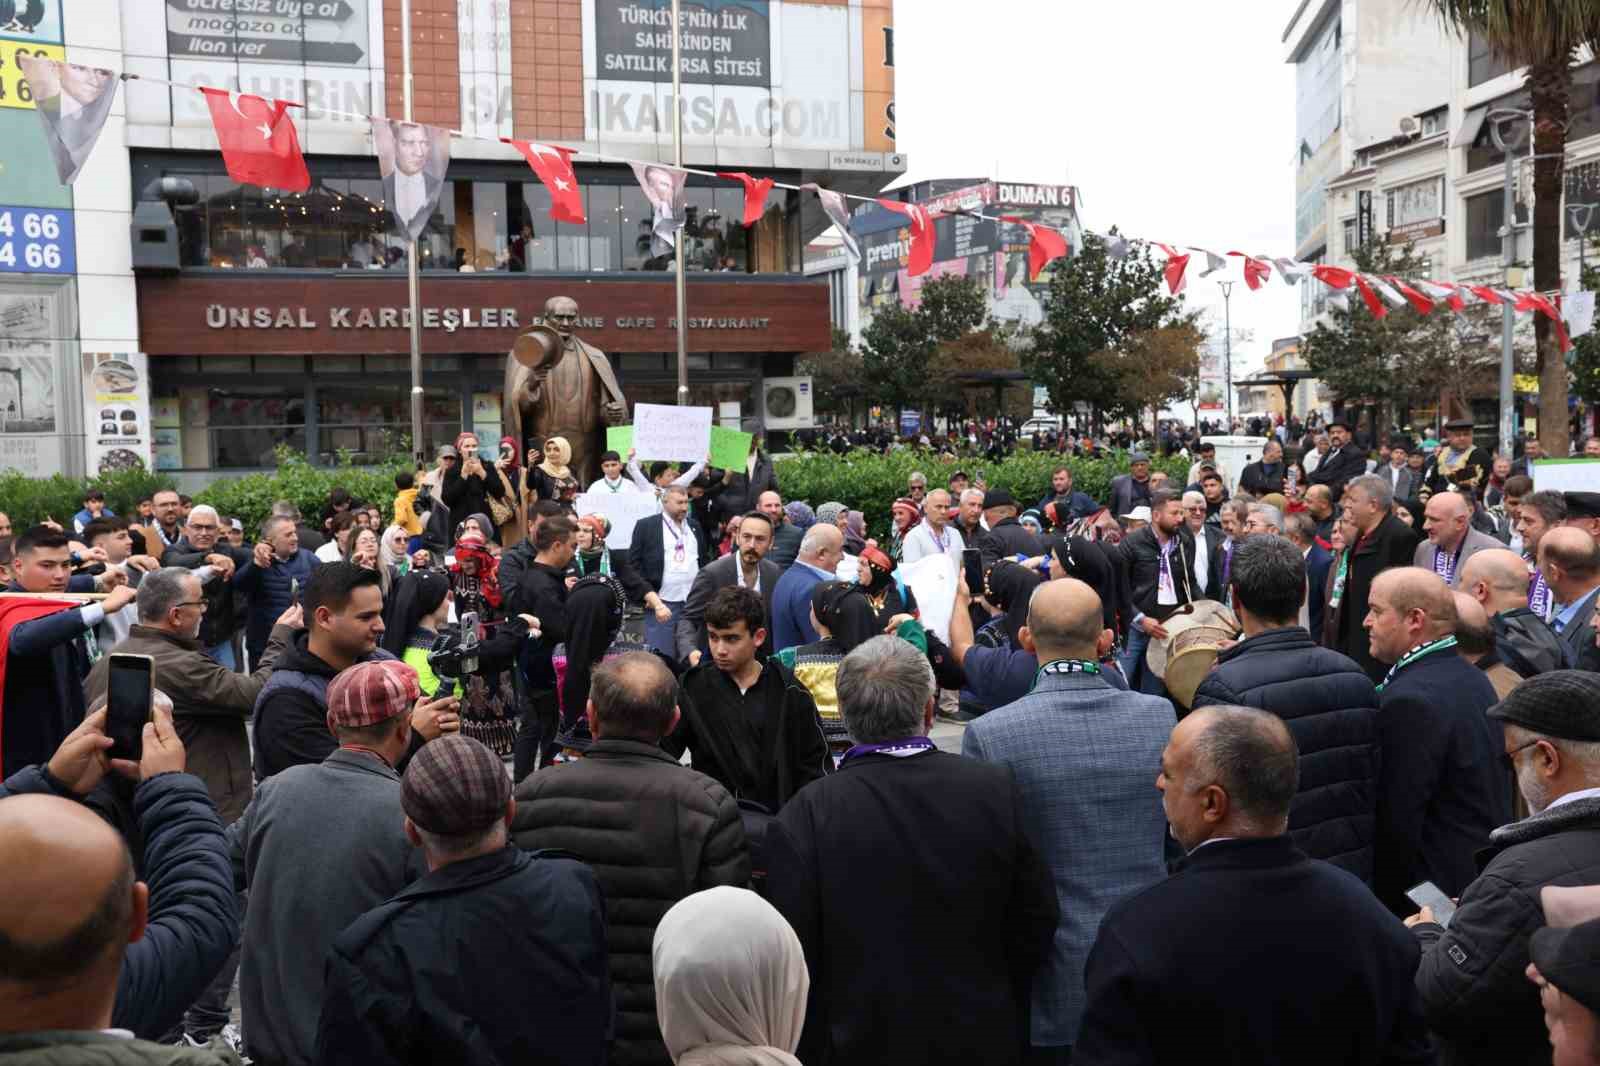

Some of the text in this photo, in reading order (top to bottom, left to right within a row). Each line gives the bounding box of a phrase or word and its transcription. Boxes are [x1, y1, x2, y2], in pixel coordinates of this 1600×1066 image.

[319, 1, 338, 17] ol
[721, 10, 748, 31] İLK
[635, 30, 732, 52] SAHİİNDEN
[604, 54, 763, 77] SATILIK RSA SİTESİ
[999, 184, 1058, 204] DUMAN
[1061, 187, 1071, 206] 6
[23, 212, 60, 240] 66
[24, 242, 61, 269] 66
[206, 304, 317, 329] ÜNSAL
[616, 317, 656, 329] CAFE
[667, 317, 770, 329] RSTAURANT
